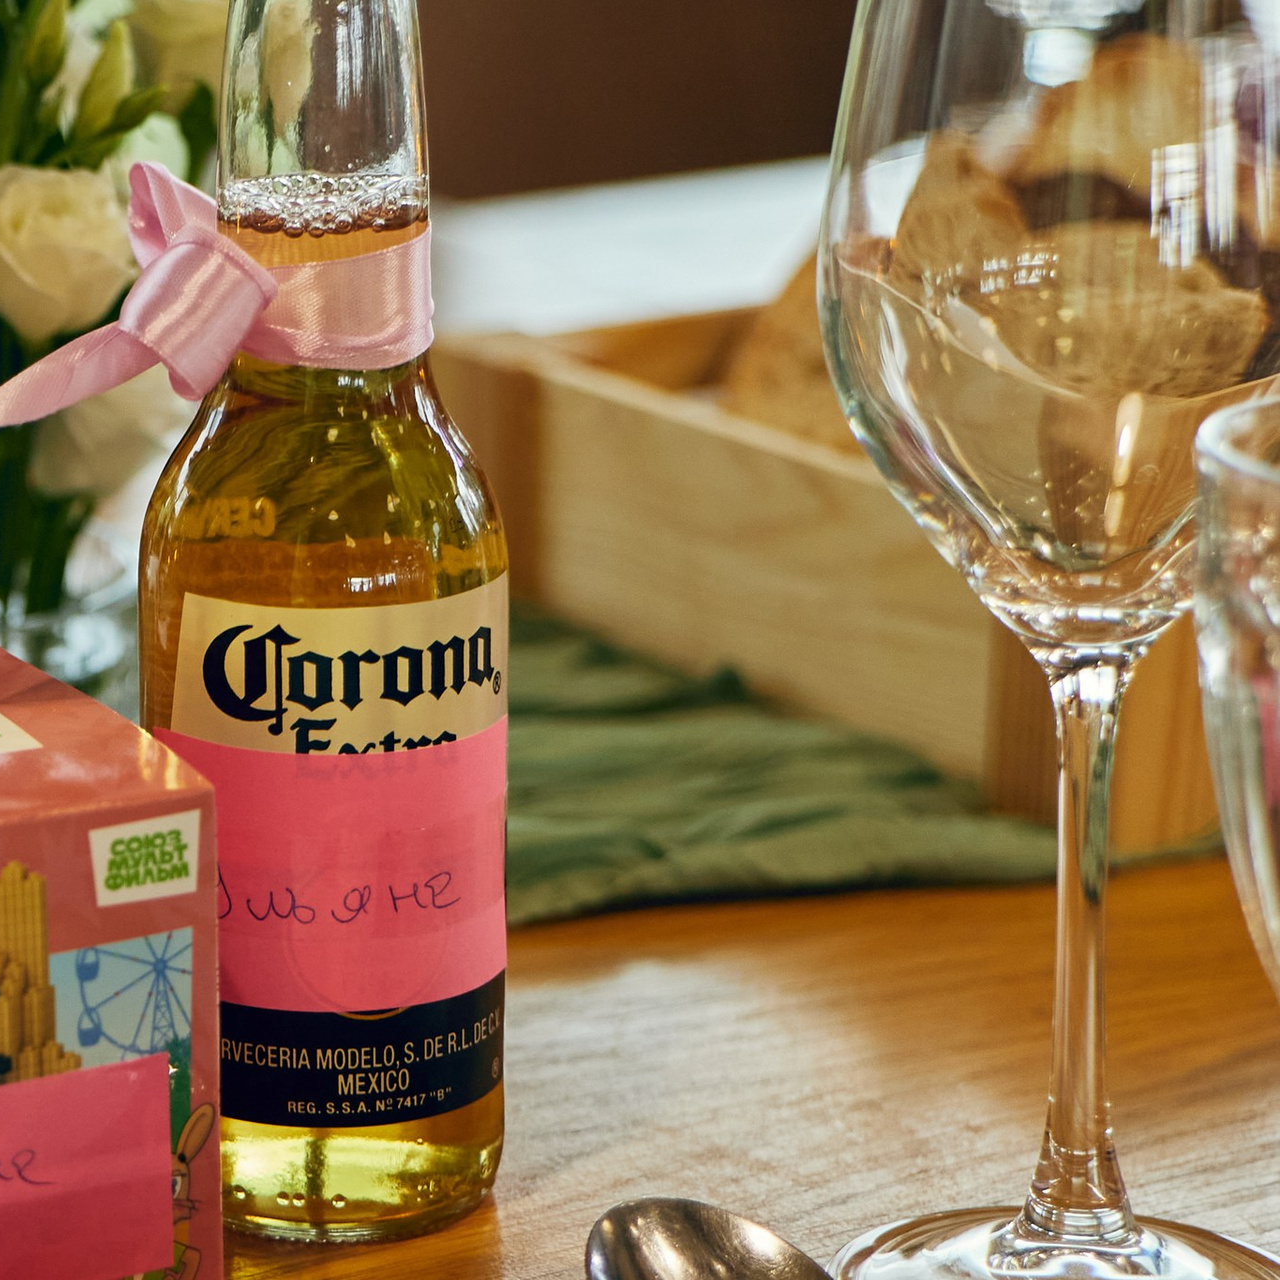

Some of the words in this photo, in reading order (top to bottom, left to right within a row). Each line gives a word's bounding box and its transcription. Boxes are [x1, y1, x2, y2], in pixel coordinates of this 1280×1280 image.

[202, 623, 495, 736] Corona
[108, 842, 188, 873] МУЛЬТ
[111, 829, 182, 856] СОЮЗ
[104, 861, 189, 891] ФИЛЬМ
[316, 1045, 400, 1070] MODELO,
[404, 1042, 420, 1064] S.
[424, 1036, 444, 1060] DE
[448, 1028, 472, 1054] R.L.
[338, 1068, 410, 1096] MEXICO
[287, 1101, 322, 1114] REG.
[396, 1093, 426, 1110] 7417
